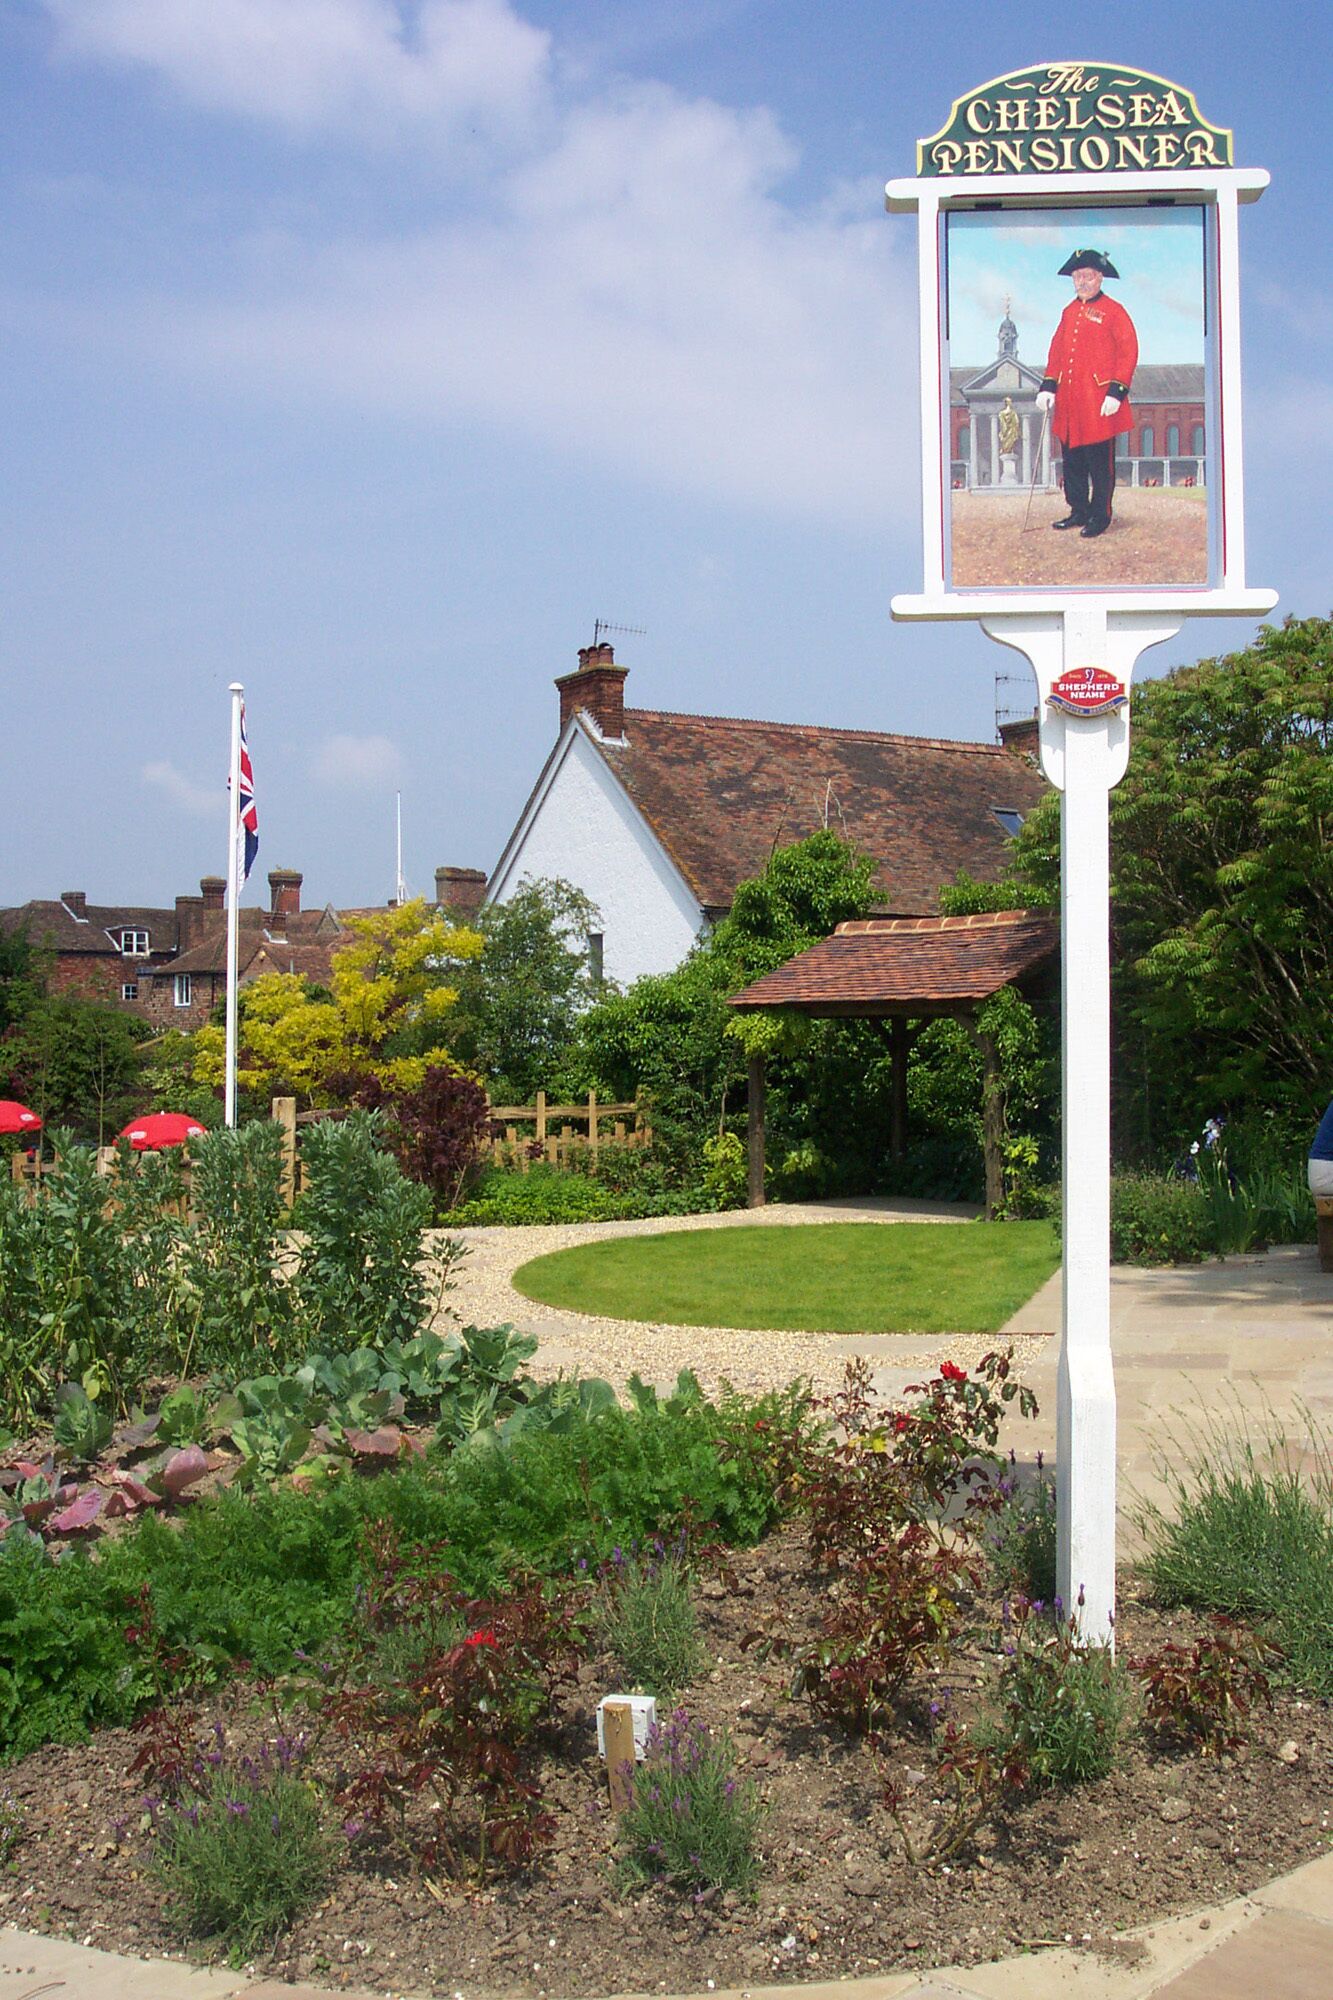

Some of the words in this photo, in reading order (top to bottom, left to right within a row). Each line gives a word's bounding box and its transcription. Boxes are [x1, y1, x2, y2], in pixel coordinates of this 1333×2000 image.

[1039, 66, 1099, 94] The
[966, 90, 1191, 134] CHELSEA
[931, 130, 1225, 174] PENSIONER
[1058, 683, 1119, 692] SHEPHERD
[1070, 691, 1106, 699] NEAME
